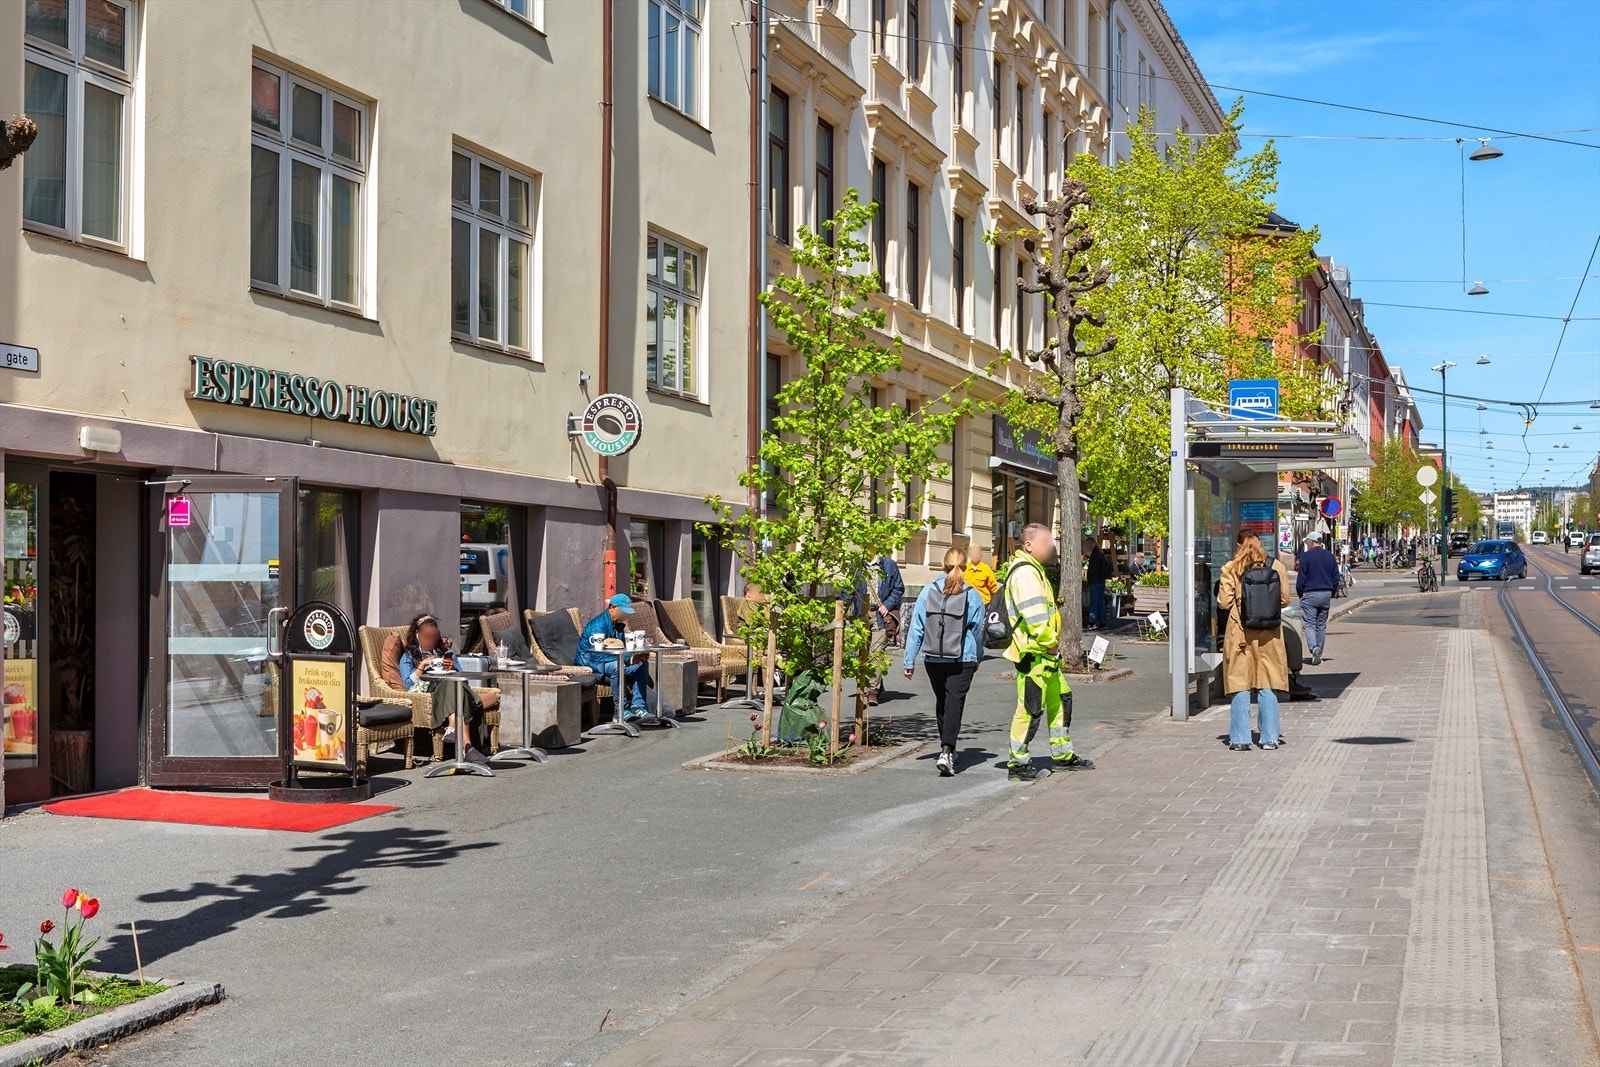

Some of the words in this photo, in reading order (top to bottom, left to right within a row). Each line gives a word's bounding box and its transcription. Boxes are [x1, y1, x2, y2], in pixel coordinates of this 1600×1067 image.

[6, 352, 28, 366] gate
[192, 354, 344, 420] ESPRESSO
[347, 384, 438, 436] HOUSE
[586, 398, 634, 420] ESPRESSO
[590, 437, 628, 452] HOUSE
[306, 612, 332, 628] ESPRESSO
[304, 667, 320, 676] Frisk
[320, 670, 335, 679] opp
[298, 676, 329, 686] frokosten
[329, 678, 341, 687] din
